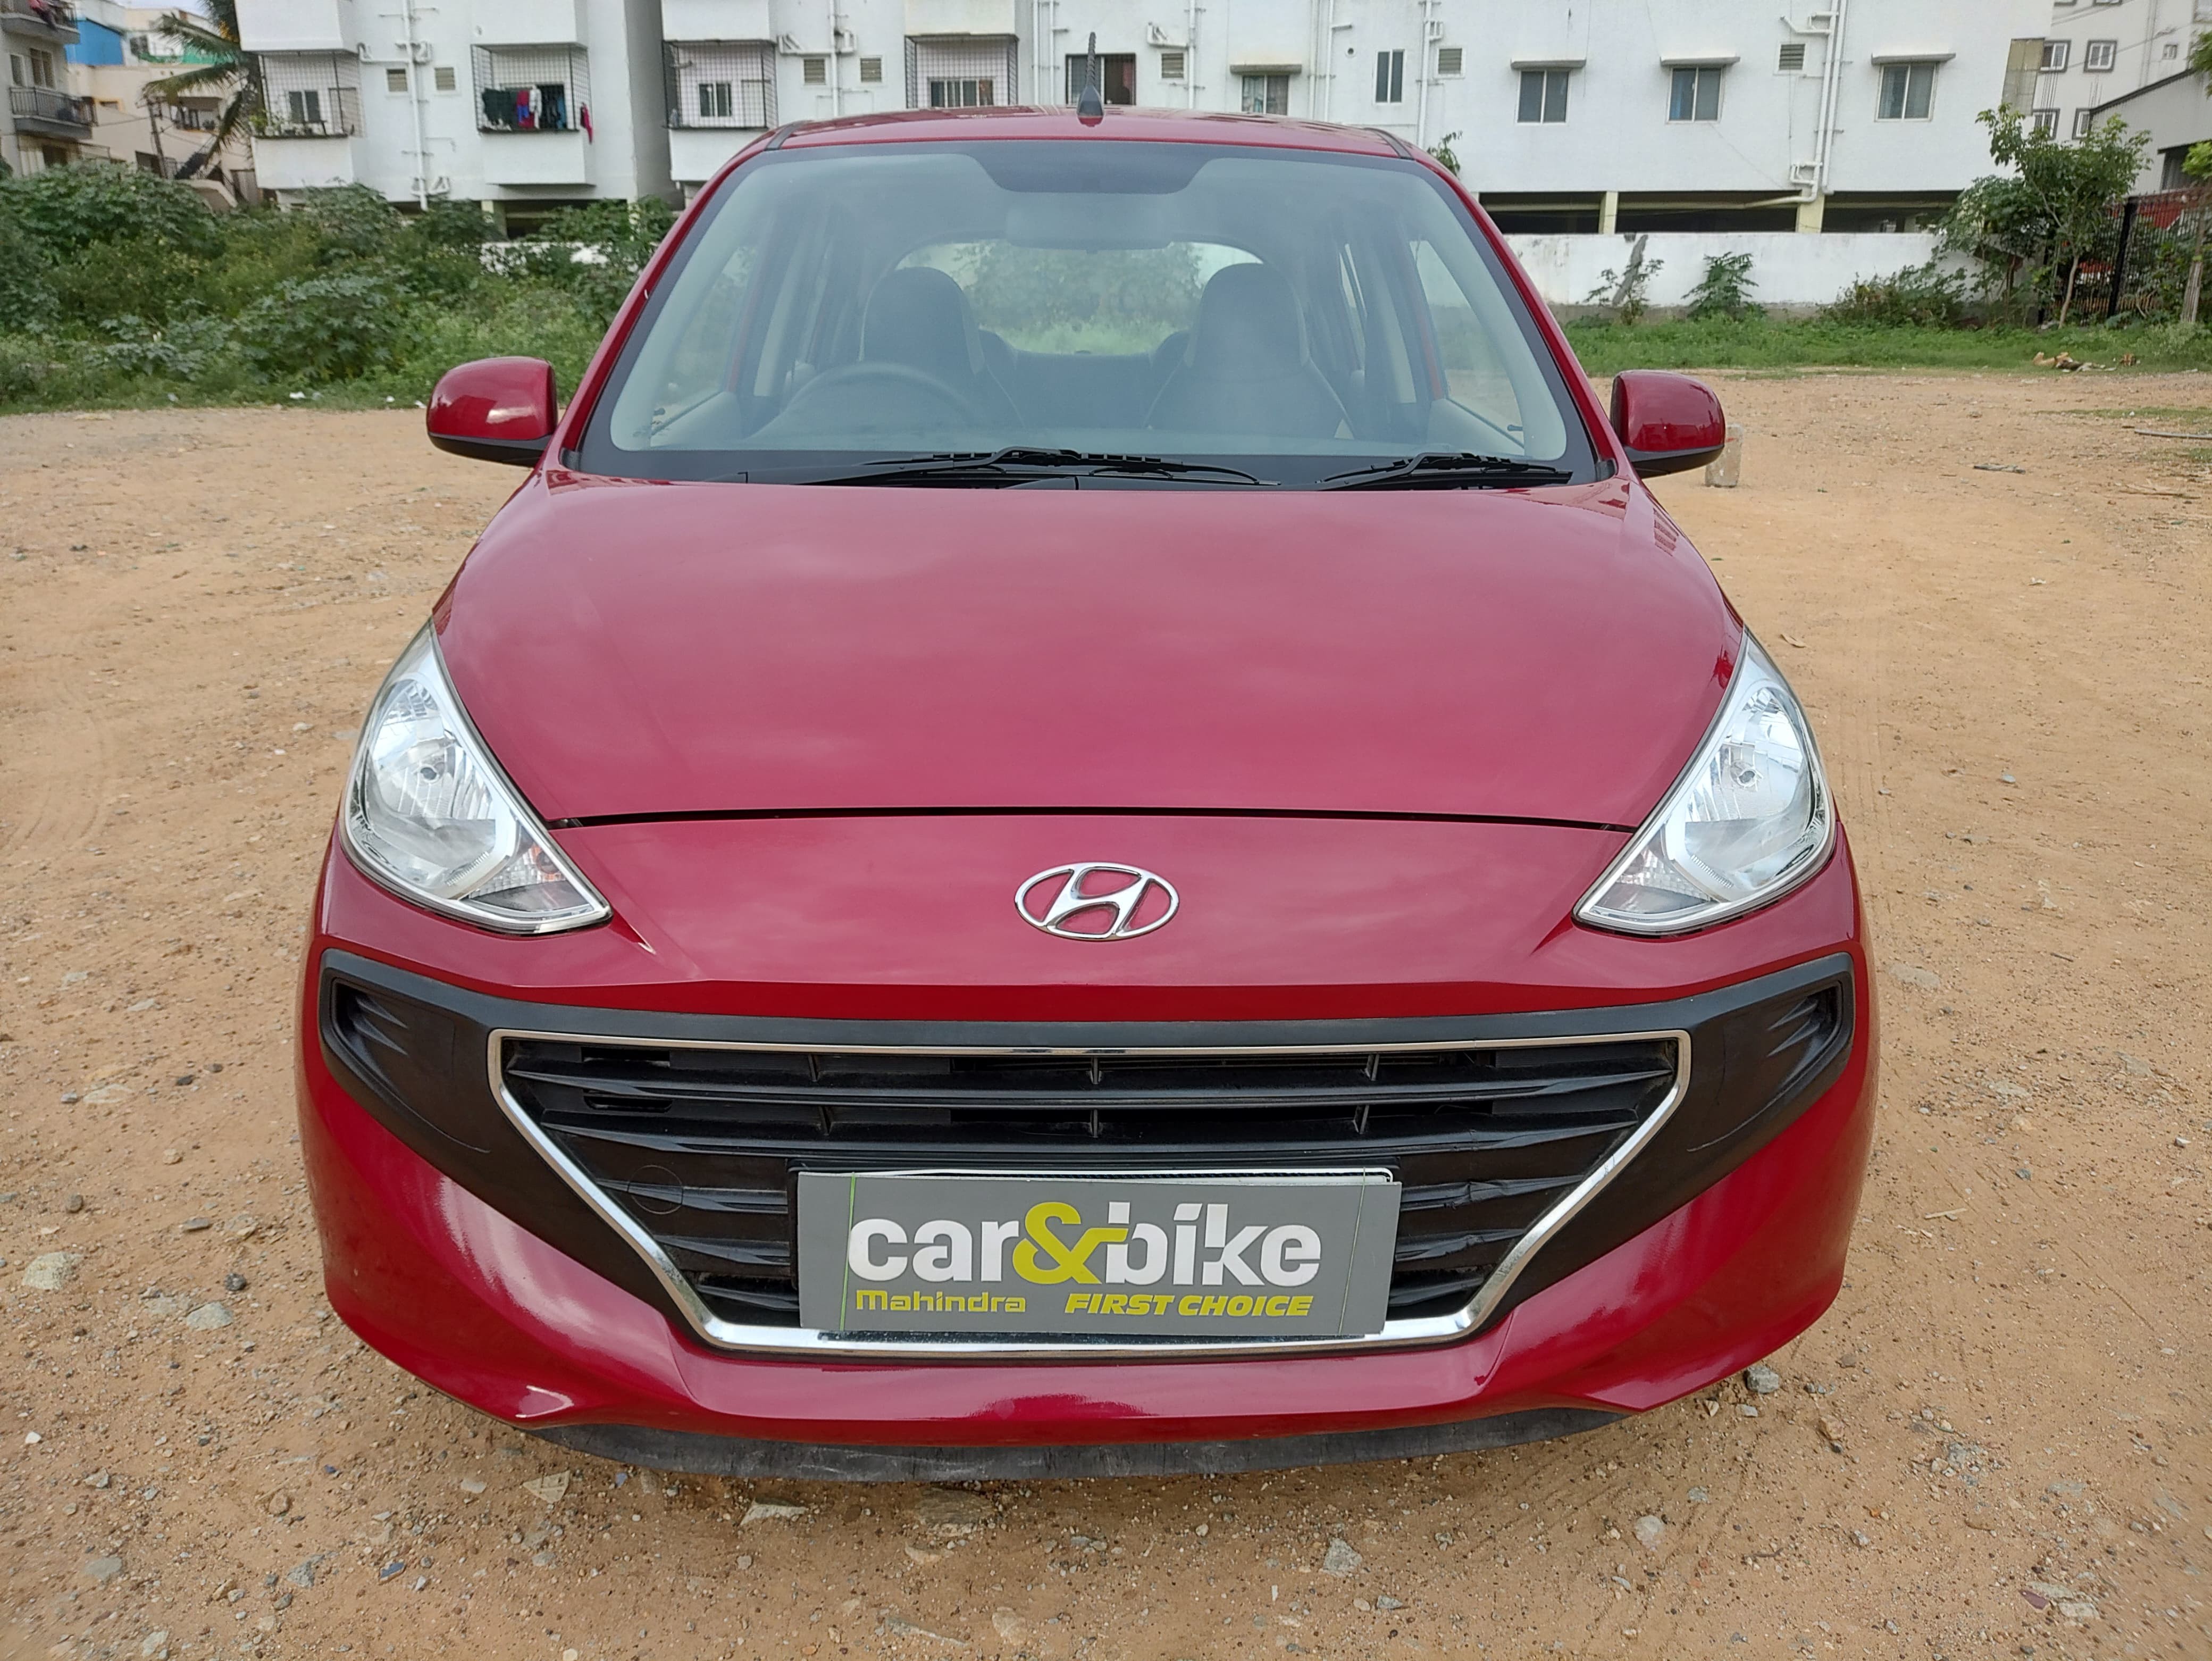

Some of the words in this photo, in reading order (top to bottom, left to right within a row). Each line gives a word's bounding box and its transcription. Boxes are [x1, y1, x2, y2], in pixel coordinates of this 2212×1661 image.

[855, 1289, 1026, 1314] Mahindra
[1065, 1293, 1174, 1316] FIRST
[1177, 1293, 1313, 1317] CHOICE
